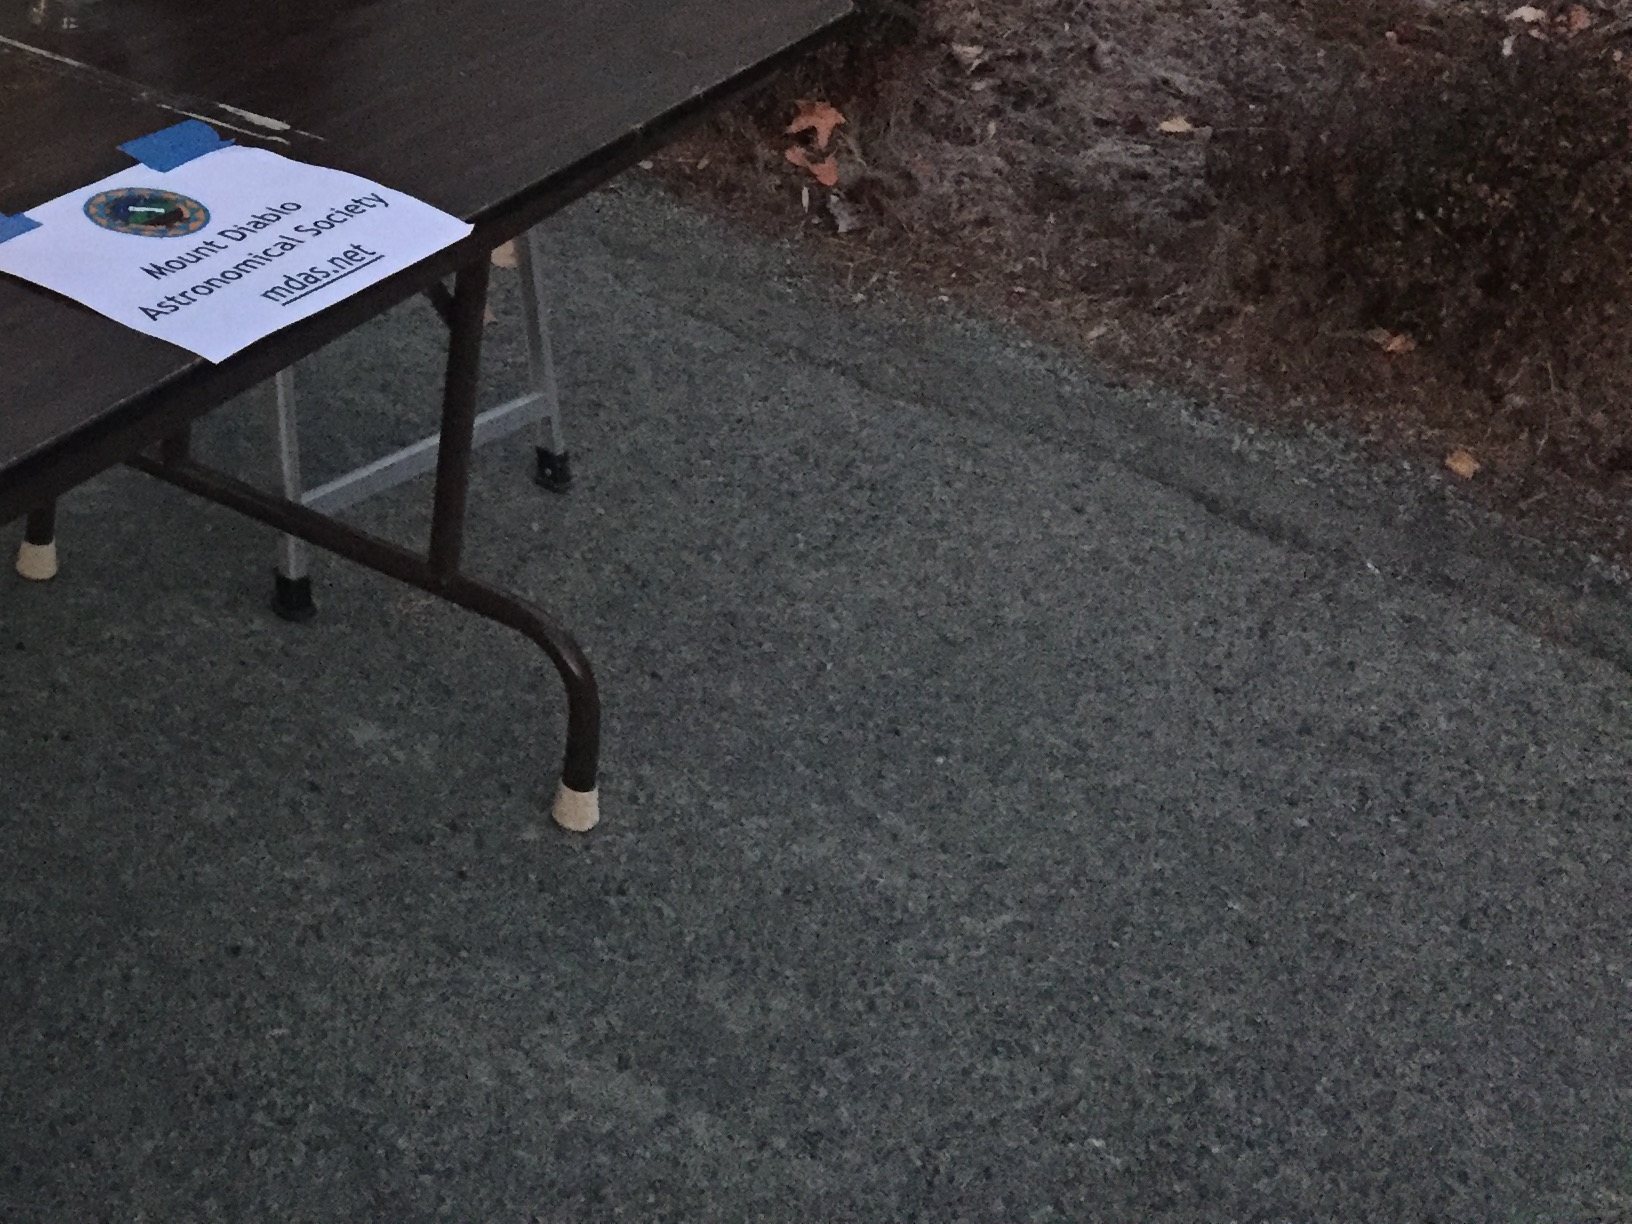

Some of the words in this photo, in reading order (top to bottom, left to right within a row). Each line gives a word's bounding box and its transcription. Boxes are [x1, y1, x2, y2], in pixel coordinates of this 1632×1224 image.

[136, 234, 306, 323] Astronomical
[293, 191, 390, 238] Society
[138, 239, 229, 282] Mount
[216, 201, 303, 243] Diablo
[259, 242, 378, 303] mdas.net
